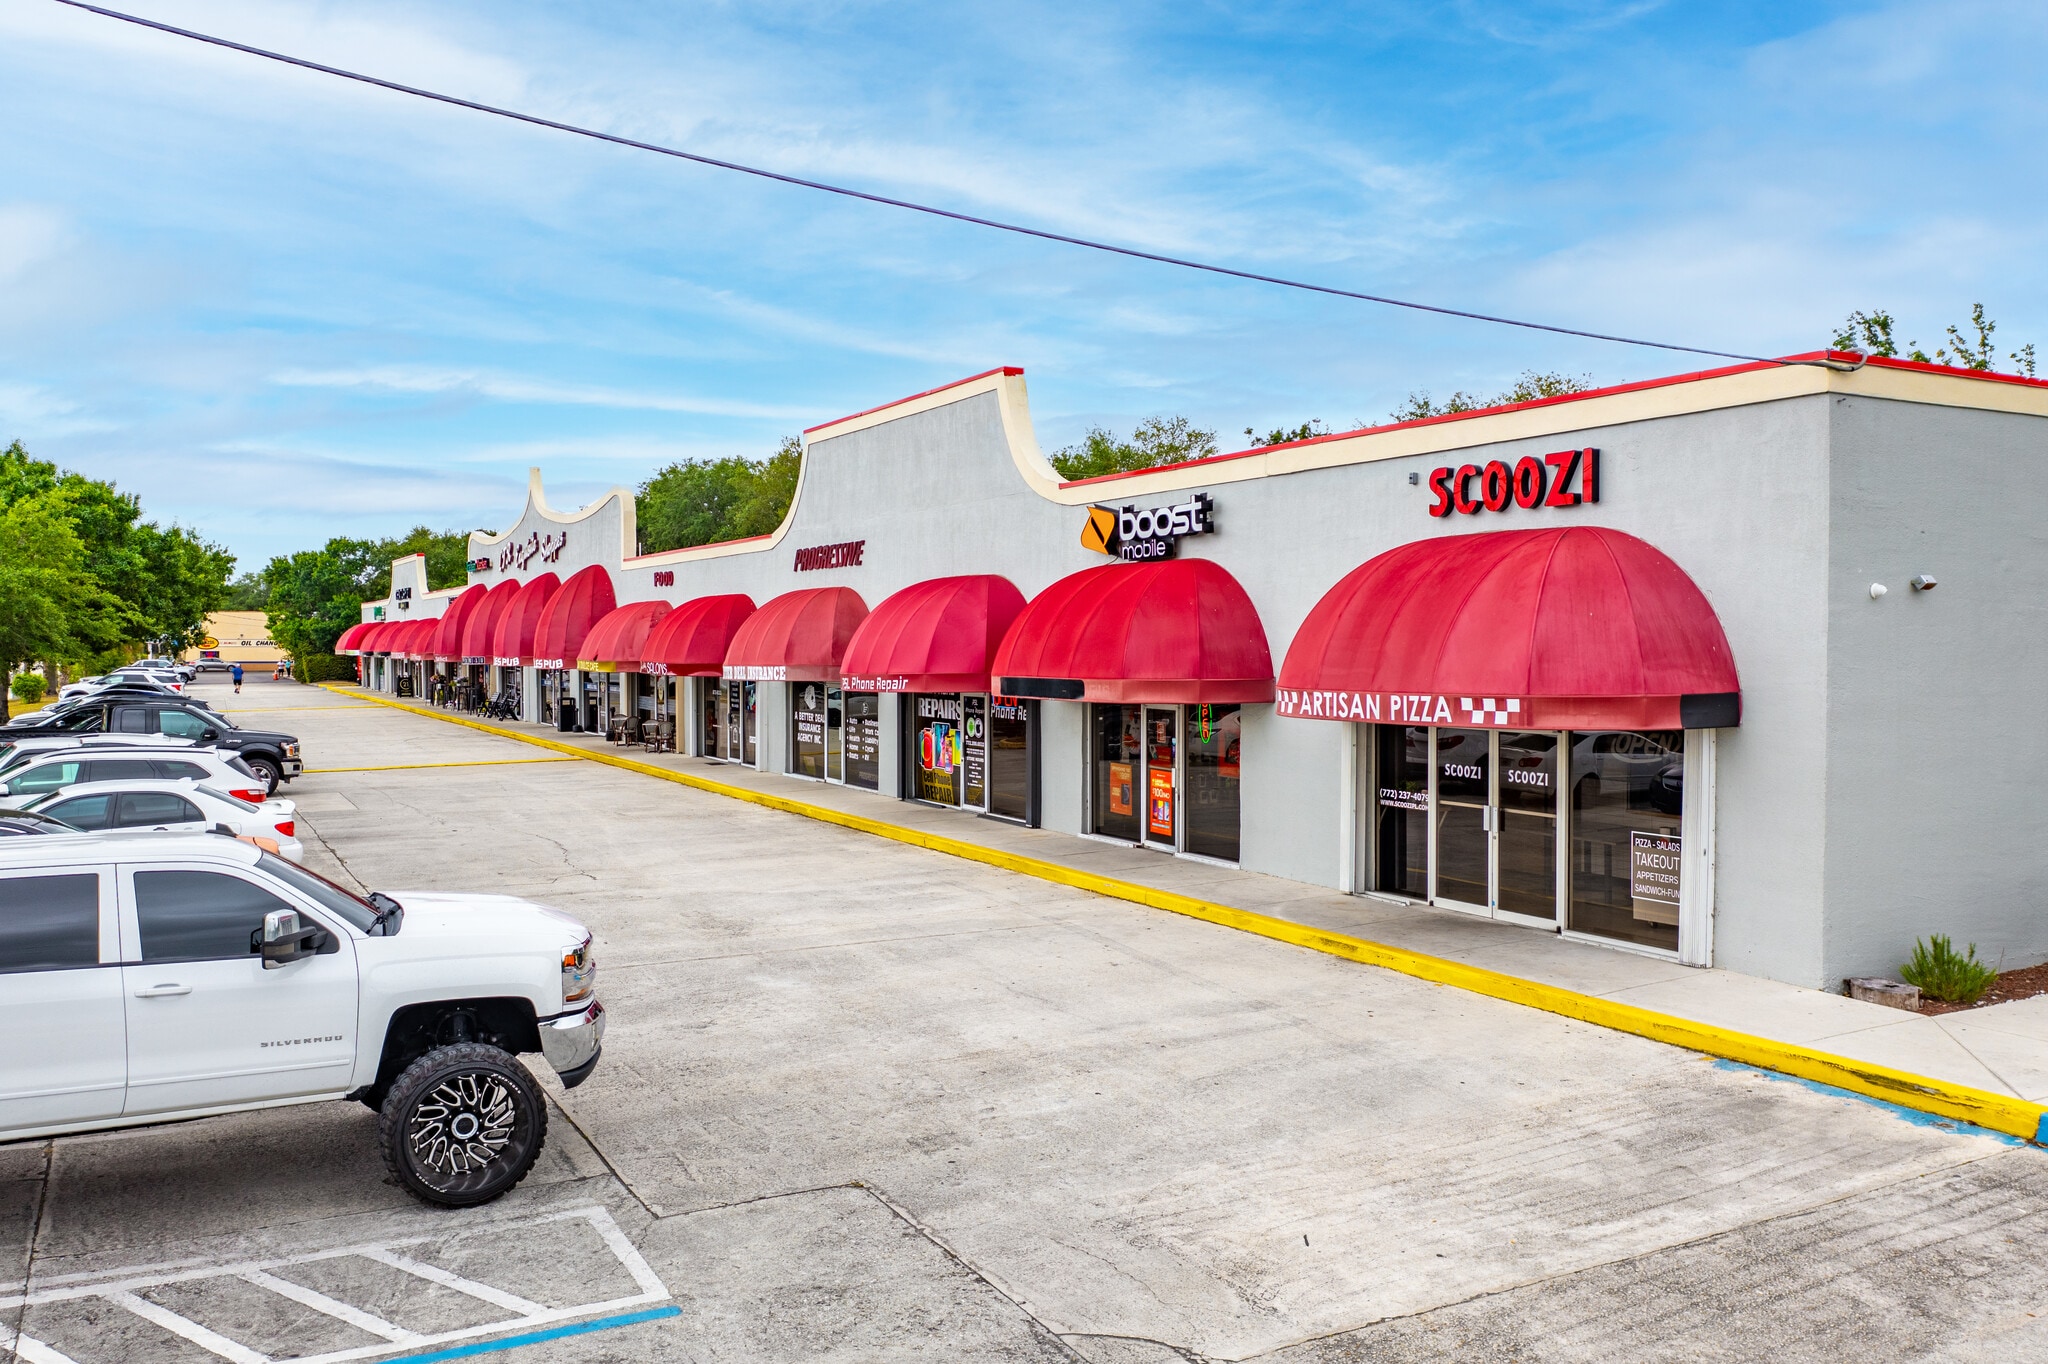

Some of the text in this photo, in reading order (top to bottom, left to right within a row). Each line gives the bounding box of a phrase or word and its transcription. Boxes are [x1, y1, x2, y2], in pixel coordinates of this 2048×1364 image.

[1429, 447, 1600, 518] SCOOZI
[1118, 494, 1205, 541] boost
[793, 540, 866, 572] PROGRESSIVE
[1122, 539, 1166, 560] mobile
[653, 570, 675, 587] FOOD
[543, 659, 564, 669] PUB
[747, 666, 786, 681] INSURANCE
[851, 676, 874, 690] Phone
[876, 675, 909, 692] Repair
[991, 704, 1015, 720] Phone
[1299, 691, 1452, 722] ARTISAN PIZZA
[798, 711, 814, 721] BETTER
[798, 722, 821, 733] INSURANCE
[797, 732, 813, 743] AGENCY
[1444, 763, 1481, 779] SCOOZI
[1507, 769, 1548, 786] SCOOZI
[925, 785, 953, 803] REPAIR
[1380, 788, 1398, 800] (772)
[1634, 837, 1651, 848] PIZZA
[1656, 840, 1681, 852] SALADS
[1634, 851, 1681, 871] TAKEOUT
[1636, 870, 1679, 885] APPETIZERS
